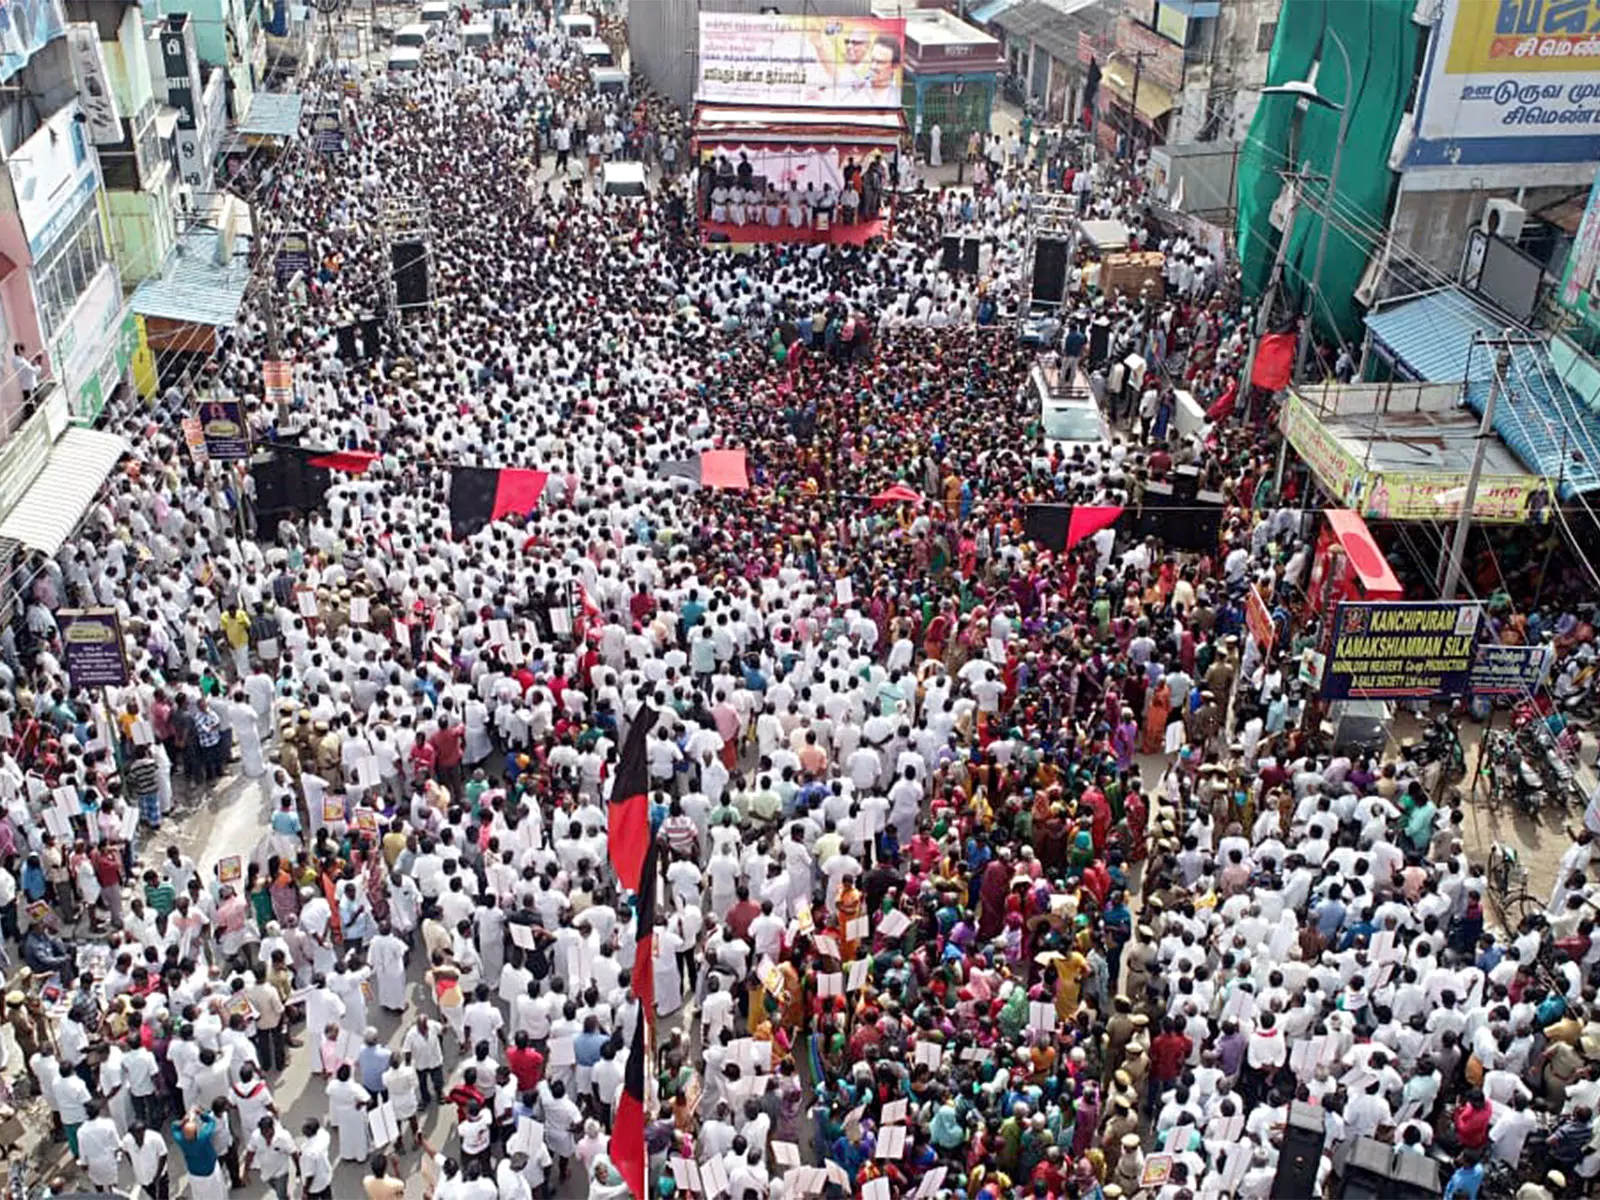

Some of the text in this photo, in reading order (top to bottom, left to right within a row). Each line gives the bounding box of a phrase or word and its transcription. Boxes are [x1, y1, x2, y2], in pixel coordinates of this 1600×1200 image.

[1461, 80, 1563, 105] ஊடுருவ
[1369, 610, 1457, 632] KANCHIPURAM
[1335, 636, 1443, 658] KAMAKSHIAMMAN
[1443, 635, 1473, 657] SILK
